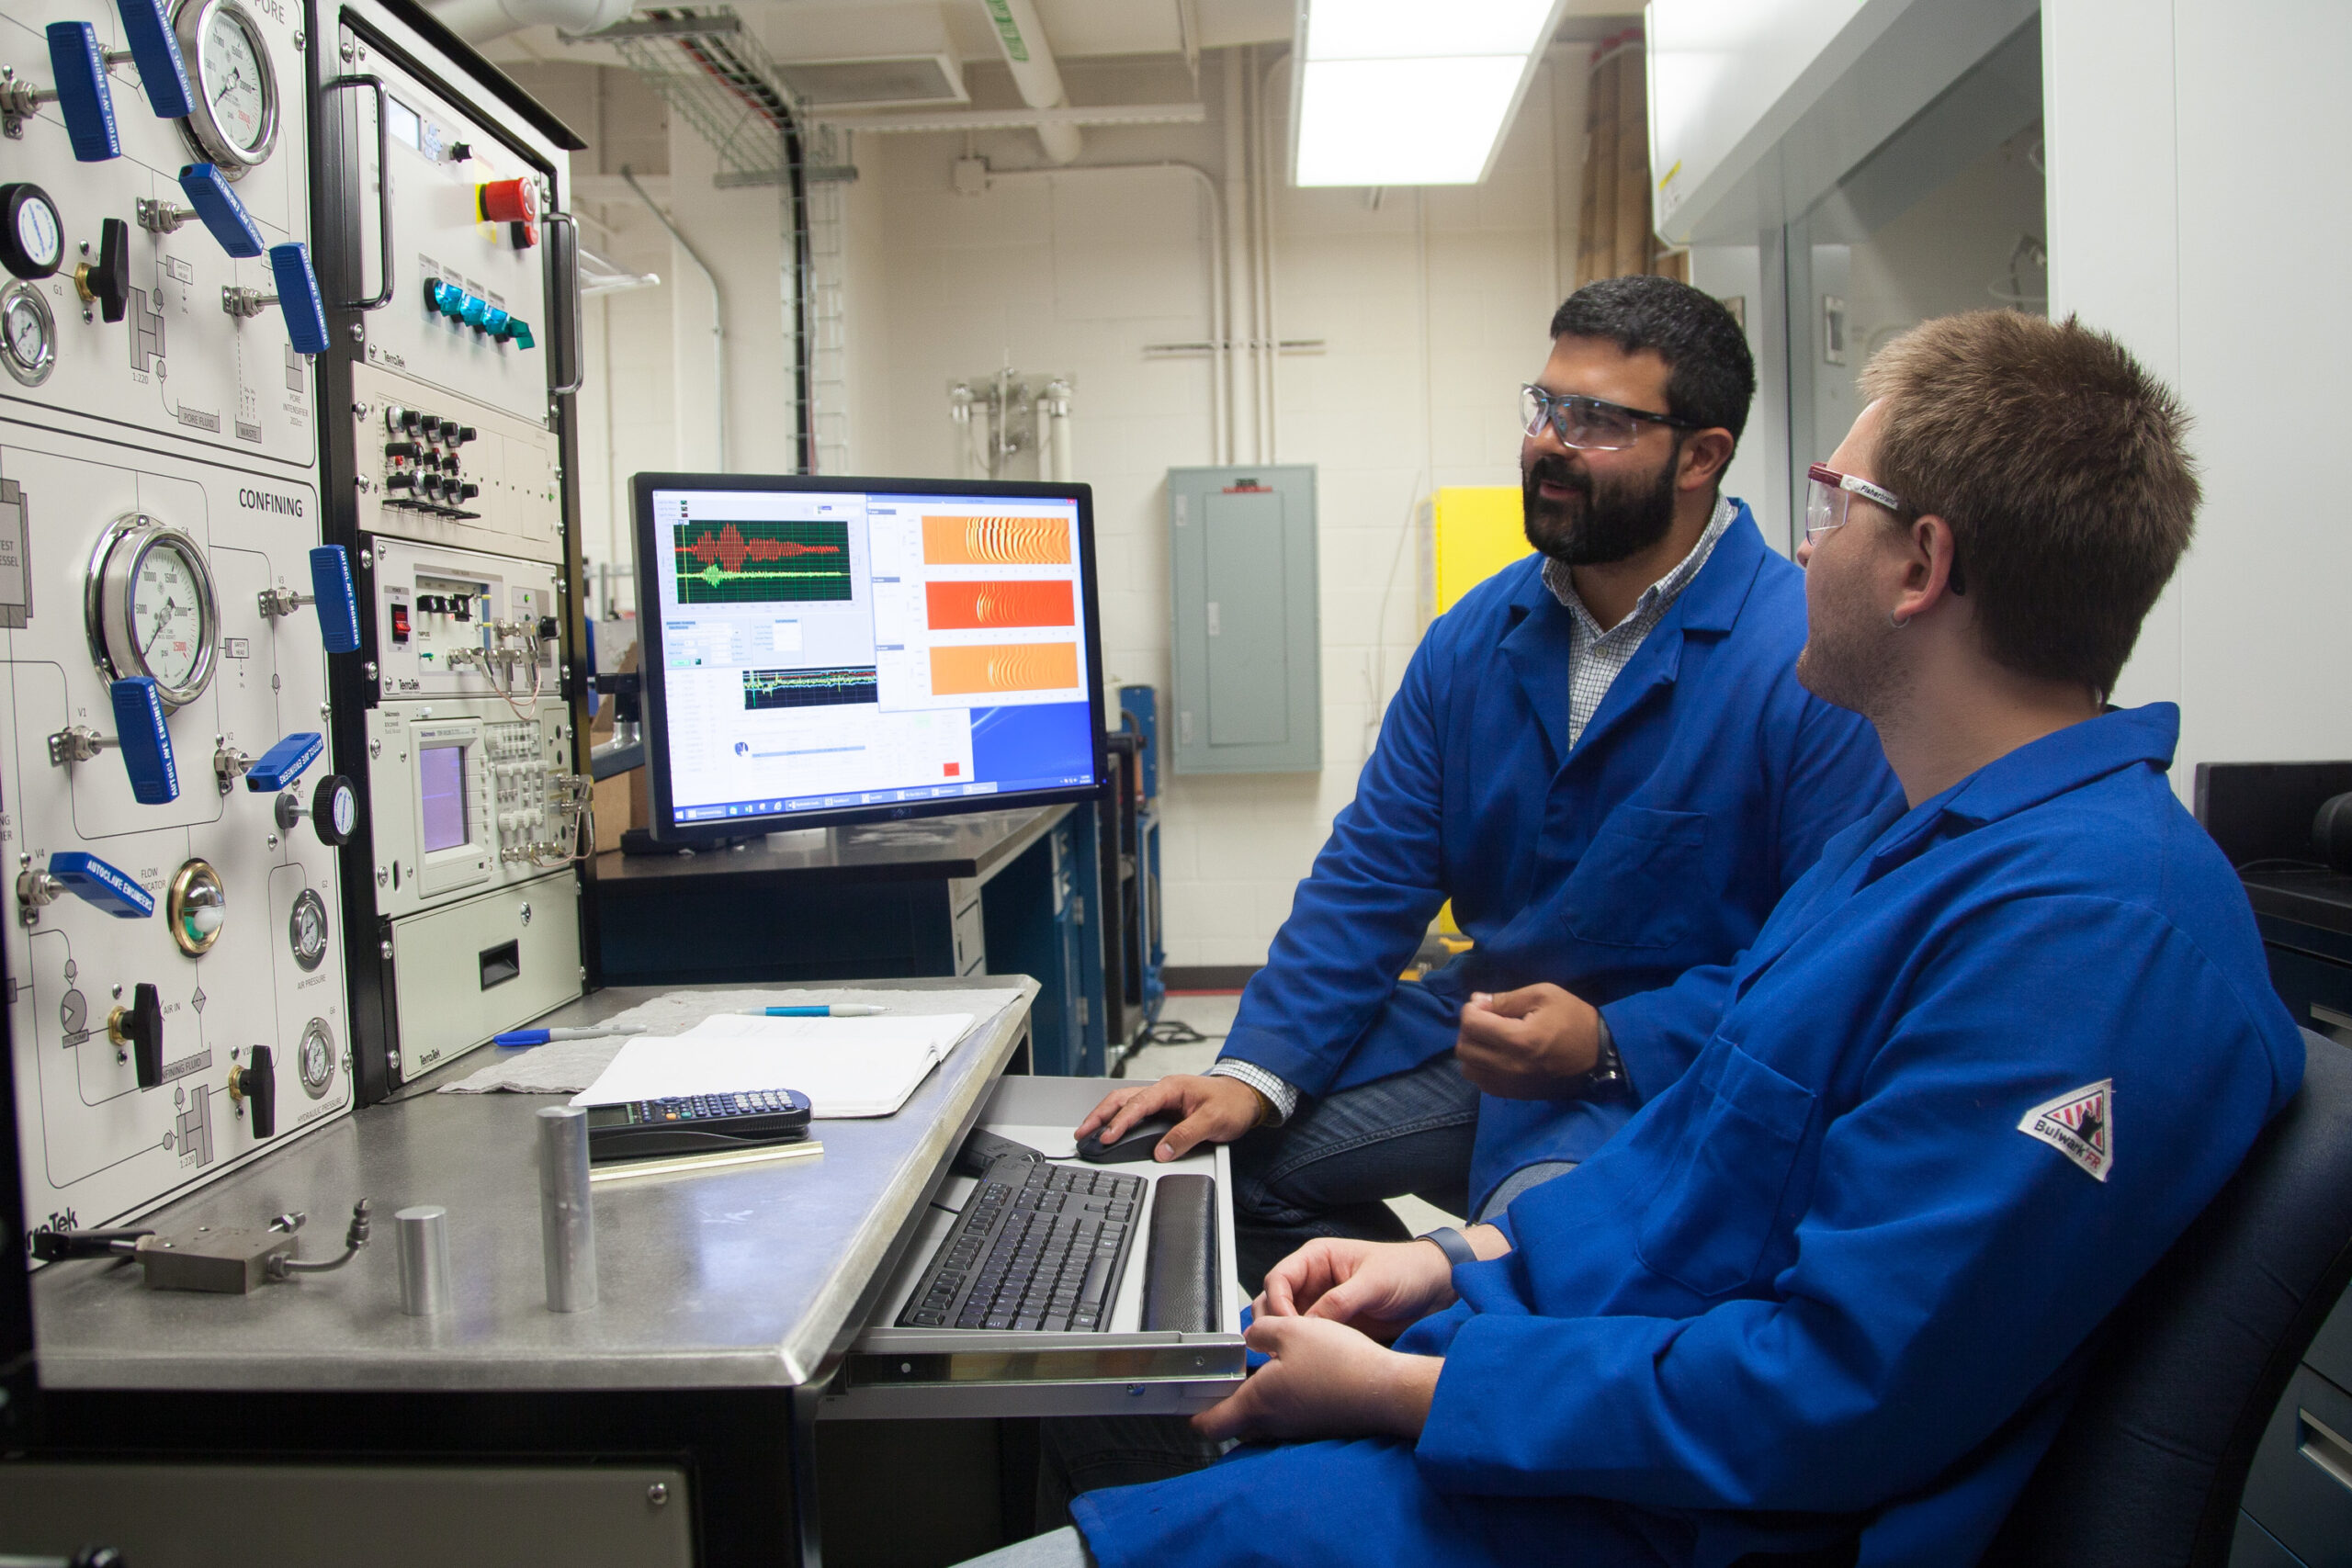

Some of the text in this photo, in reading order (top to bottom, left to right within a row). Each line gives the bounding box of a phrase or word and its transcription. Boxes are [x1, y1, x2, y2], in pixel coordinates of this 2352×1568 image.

[172, 51, 195, 108] AUTOCLAVE
[85, 27, 119, 153] AUTOCLAVE ENGINEERS
[53, 284, 62, 297] G1
[300, 247, 328, 345] AUTOCLAVE ENGINEERS
[131, 371, 150, 385] 1:220
[184, 412, 215, 429] PORE FLUID
[240, 428, 258, 439] WASTE
[239, 488, 303, 517] CONFINING
[143, 570, 157, 582] 10000
[164, 571, 177, 583] 15000
[277, 575, 285, 585] V3
[339, 550, 360, 646] AUTOCLAVE ENGINEERS
[135, 604, 148, 615] 5000
[175, 606, 187, 616] 20000
[161, 648, 169, 658] psi
[173, 641, 187, 652] 25000
[398, 679, 421, 691] TerraTek
[77, 707, 87, 717] V1
[147, 684, 178, 795] AUTOCLAVE ENGINEERS
[226, 731, 234, 741] V2
[277, 739, 322, 784] AUTOCLAVE ENGINEERS
[35, 848, 45, 859] V4
[141, 867, 158, 879] FLOW
[85, 860, 153, 910] AUTOCLAVE ENGINEERS
[141, 879, 166, 892] DICATOR
[297, 974, 327, 991] AIR PRESSURE
[164, 1002, 181, 1016] AIR IN
[162, 1057, 201, 1080] NFINING FLUID
[297, 1096, 344, 1125] HYDRAULIC PRESSURE
[2033, 1119, 2102, 1169] Bulwark FR
[179, 1154, 196, 1169] 1:220
[26, 1206, 79, 1251] rrTek
